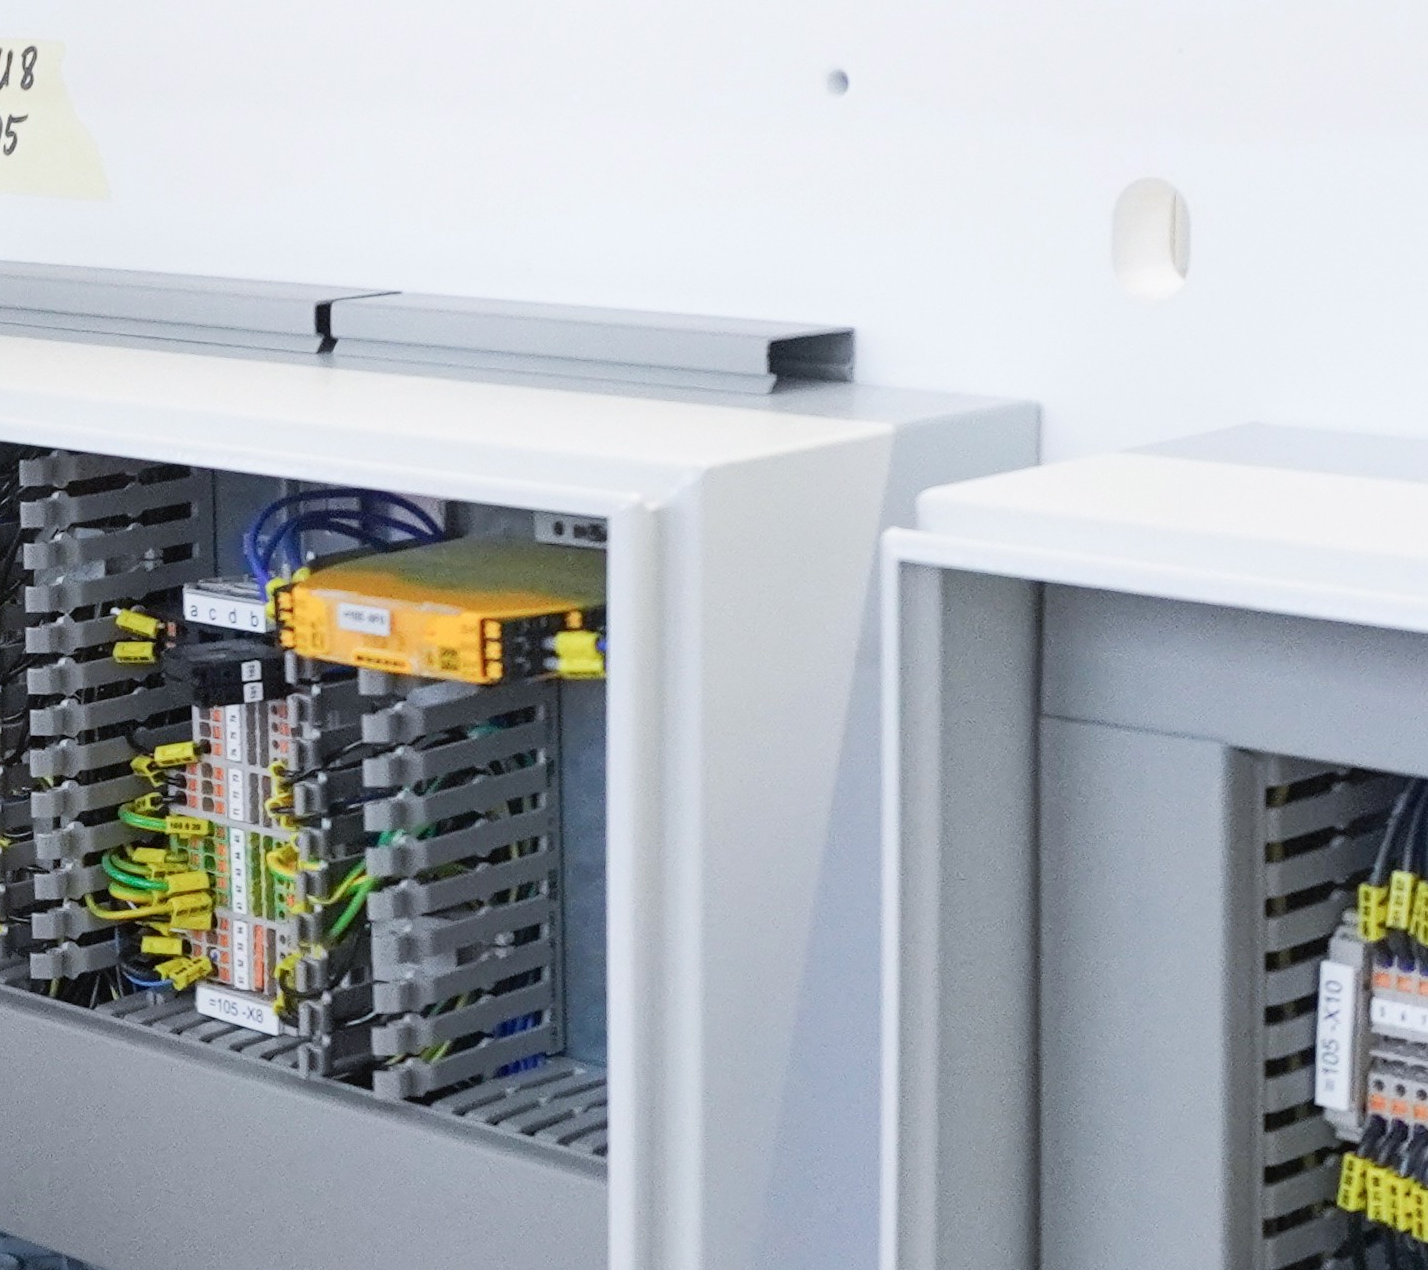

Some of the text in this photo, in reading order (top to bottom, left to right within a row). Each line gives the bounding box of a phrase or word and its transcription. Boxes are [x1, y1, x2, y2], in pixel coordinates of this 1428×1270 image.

[190, 604, 260, 627] a c d b
[209, 999, 263, 1023] =105 -X8
[1323, 980, 1342, 1031] -X10
